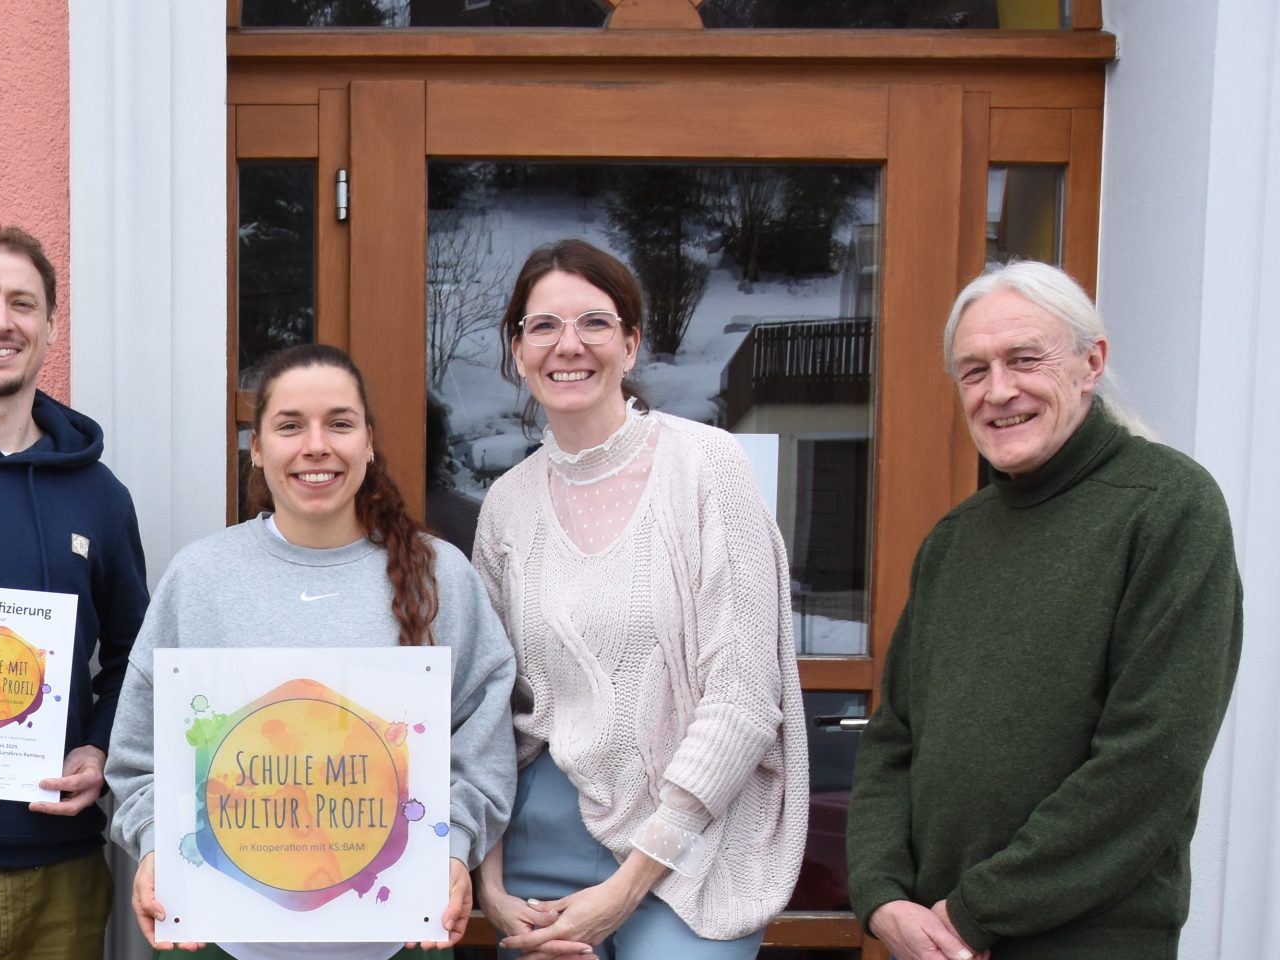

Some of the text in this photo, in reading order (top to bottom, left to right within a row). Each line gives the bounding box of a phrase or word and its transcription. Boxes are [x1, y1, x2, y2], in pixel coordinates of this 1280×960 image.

[236, 750, 369, 787] SCHULE MIT
[239, 842, 366, 854] in Kooperation mit KS:BAM
